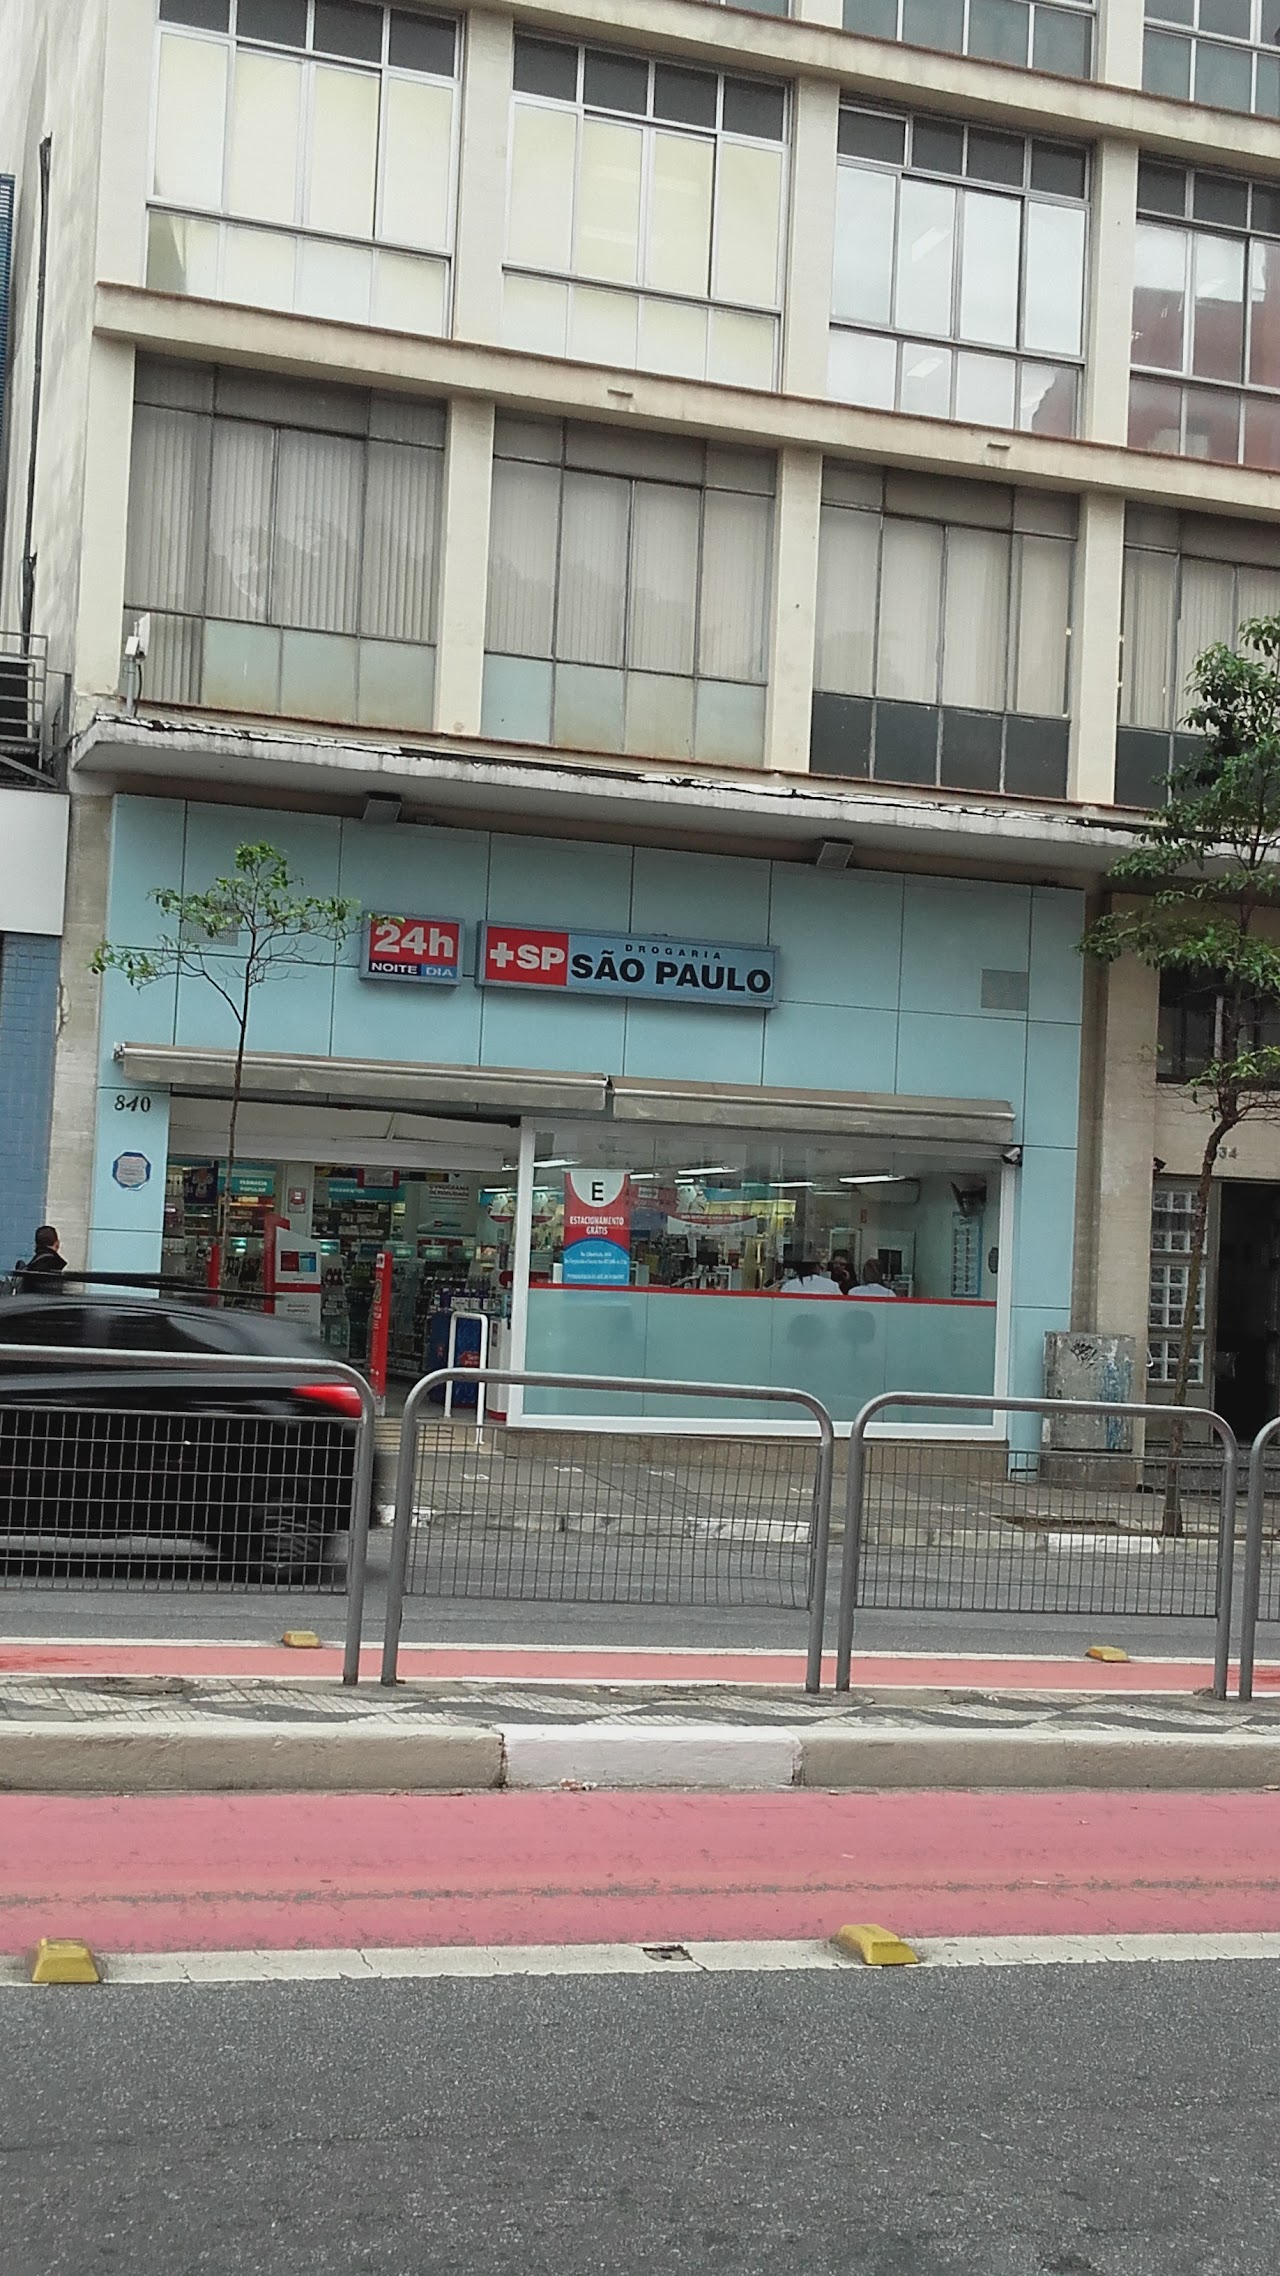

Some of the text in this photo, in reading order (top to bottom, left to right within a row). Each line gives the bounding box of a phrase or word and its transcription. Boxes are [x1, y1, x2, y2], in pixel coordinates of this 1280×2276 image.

[373, 923, 455, 959] 24h
[625, 944, 721, 960] DROGARIA
[371, 962, 453, 977] NOITE DIA
[570, 949, 645, 983] SÃO
[655, 961, 771, 994] PAULO
[114, 1094, 151, 1113] 840
[591, 1181, 604, 1201] E
[569, 1215, 625, 1226] ESTACIONAMENTO
